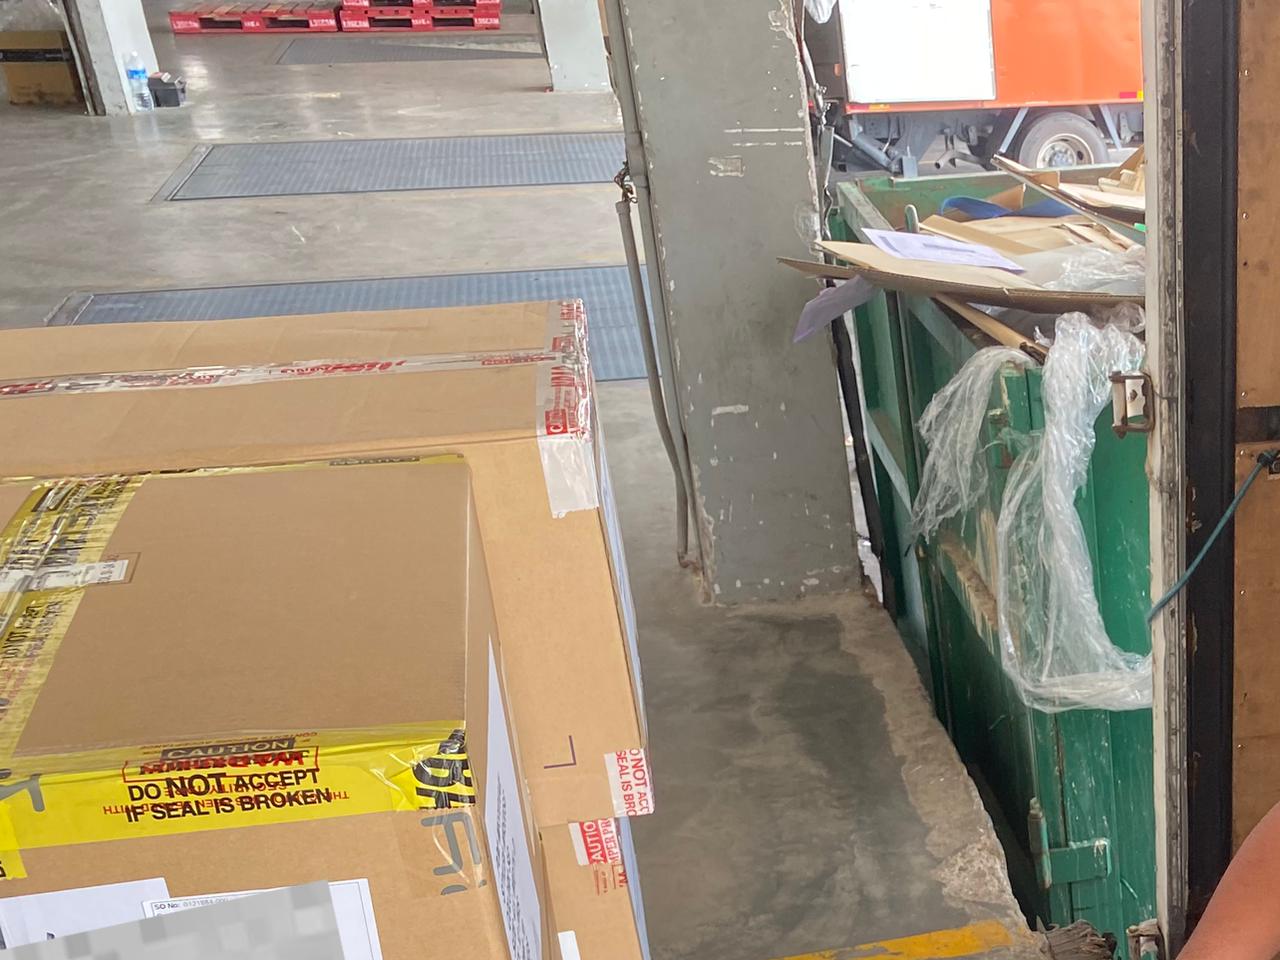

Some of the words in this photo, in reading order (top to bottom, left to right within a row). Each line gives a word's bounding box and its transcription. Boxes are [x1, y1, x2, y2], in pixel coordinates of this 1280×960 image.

[167, 739, 290, 759] CAUTION
[127, 782, 162, 801] DO
[165, 772, 227, 799] NOT
[234, 767, 320, 791] ACCEPT
[621, 780, 633, 791] IS
[631, 758, 648, 788] NOT
[125, 804, 145, 823] IF
[150, 799, 210, 820] SEAL
[213, 796, 236, 814] IS
[240, 787, 332, 812] BROKEN
[583, 821, 606, 864] AUTIO
